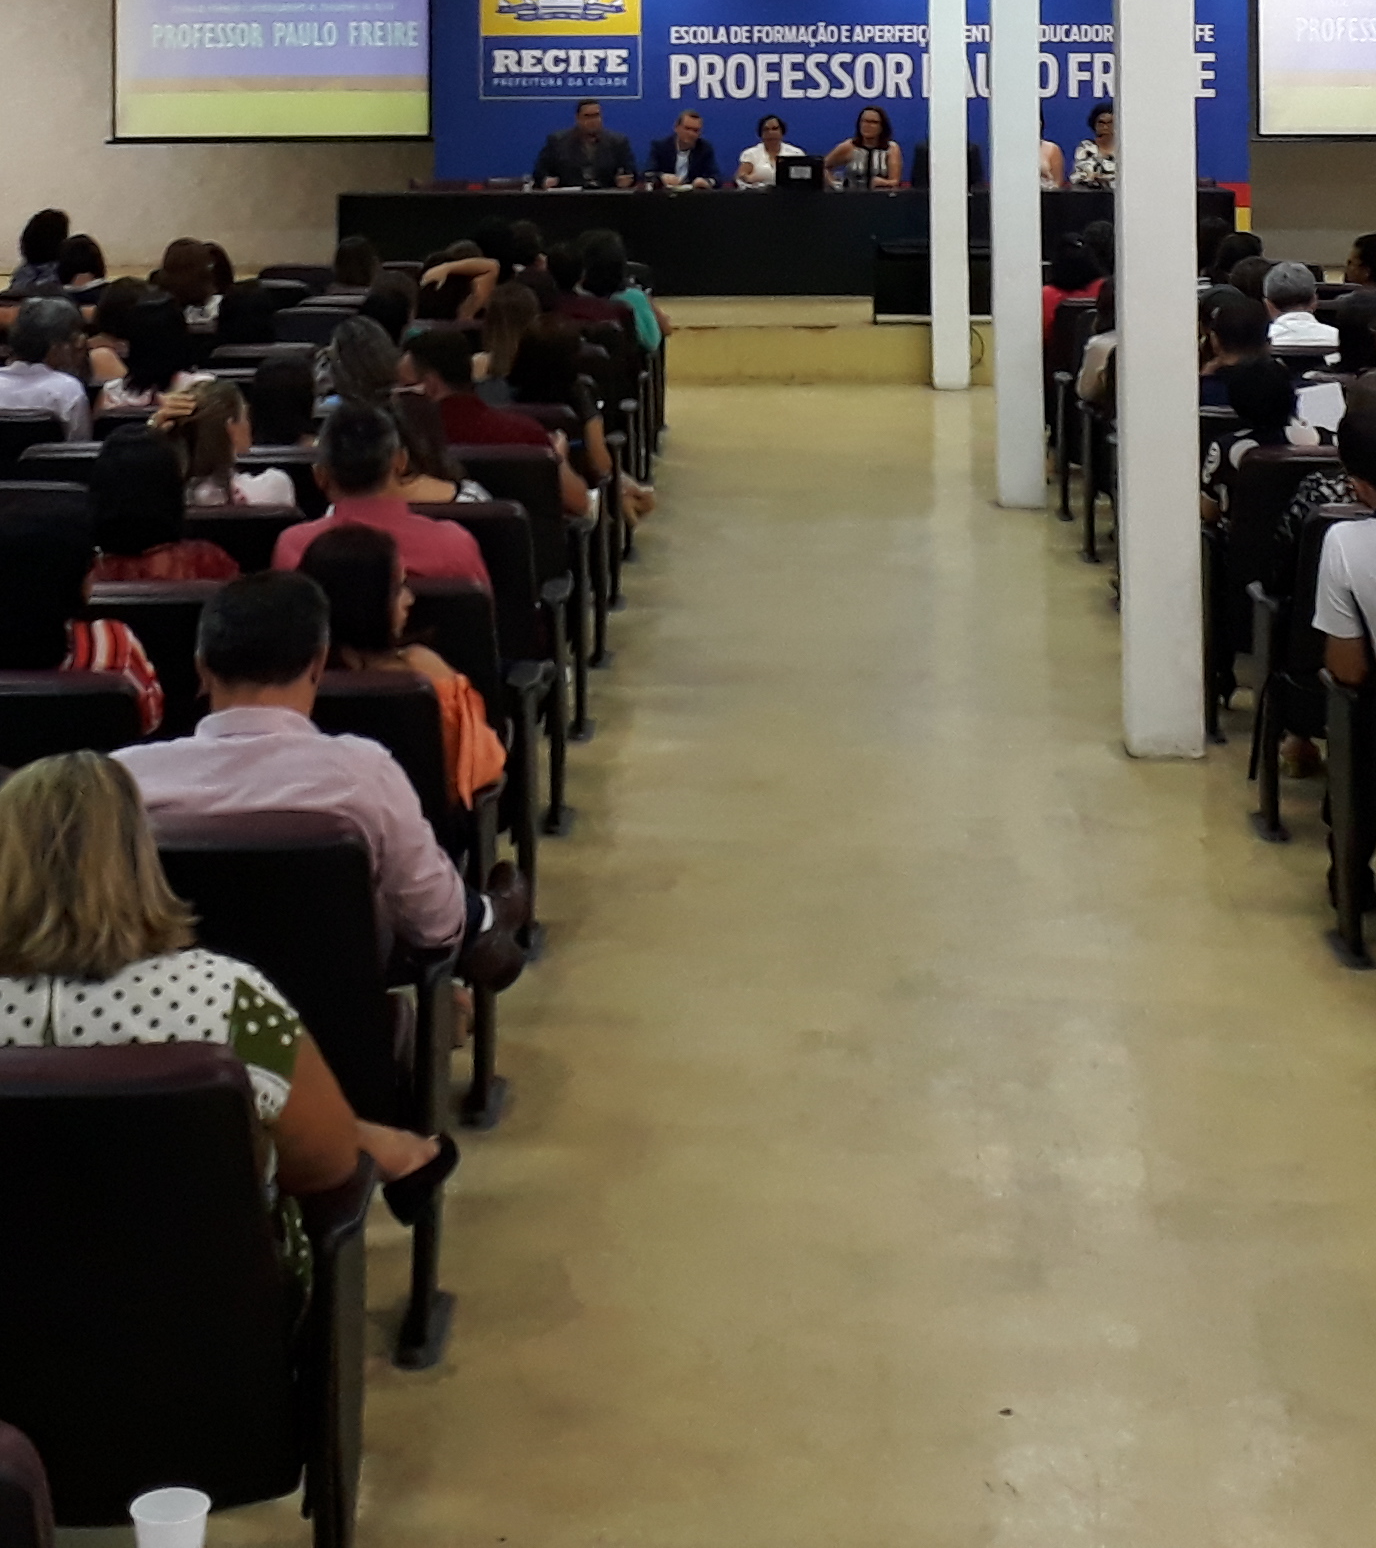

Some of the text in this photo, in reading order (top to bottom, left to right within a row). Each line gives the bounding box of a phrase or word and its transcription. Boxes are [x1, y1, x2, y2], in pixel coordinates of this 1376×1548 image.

[152, 21, 420, 48] PROFESSOR PAULO FREIRE
[669, 25, 726, 44] ESCOLA
[729, 25, 751, 44] DE
[753, 21, 839, 48] FORMAÇÃO
[842, 25, 851, 43] E
[1039, 24, 1114, 43] DUCADOR
[492, 49, 630, 73] RECIFE
[492, 76, 628, 87] PREFEITURA DA CIDADE
[669, 53, 914, 99] PROFESSOR
